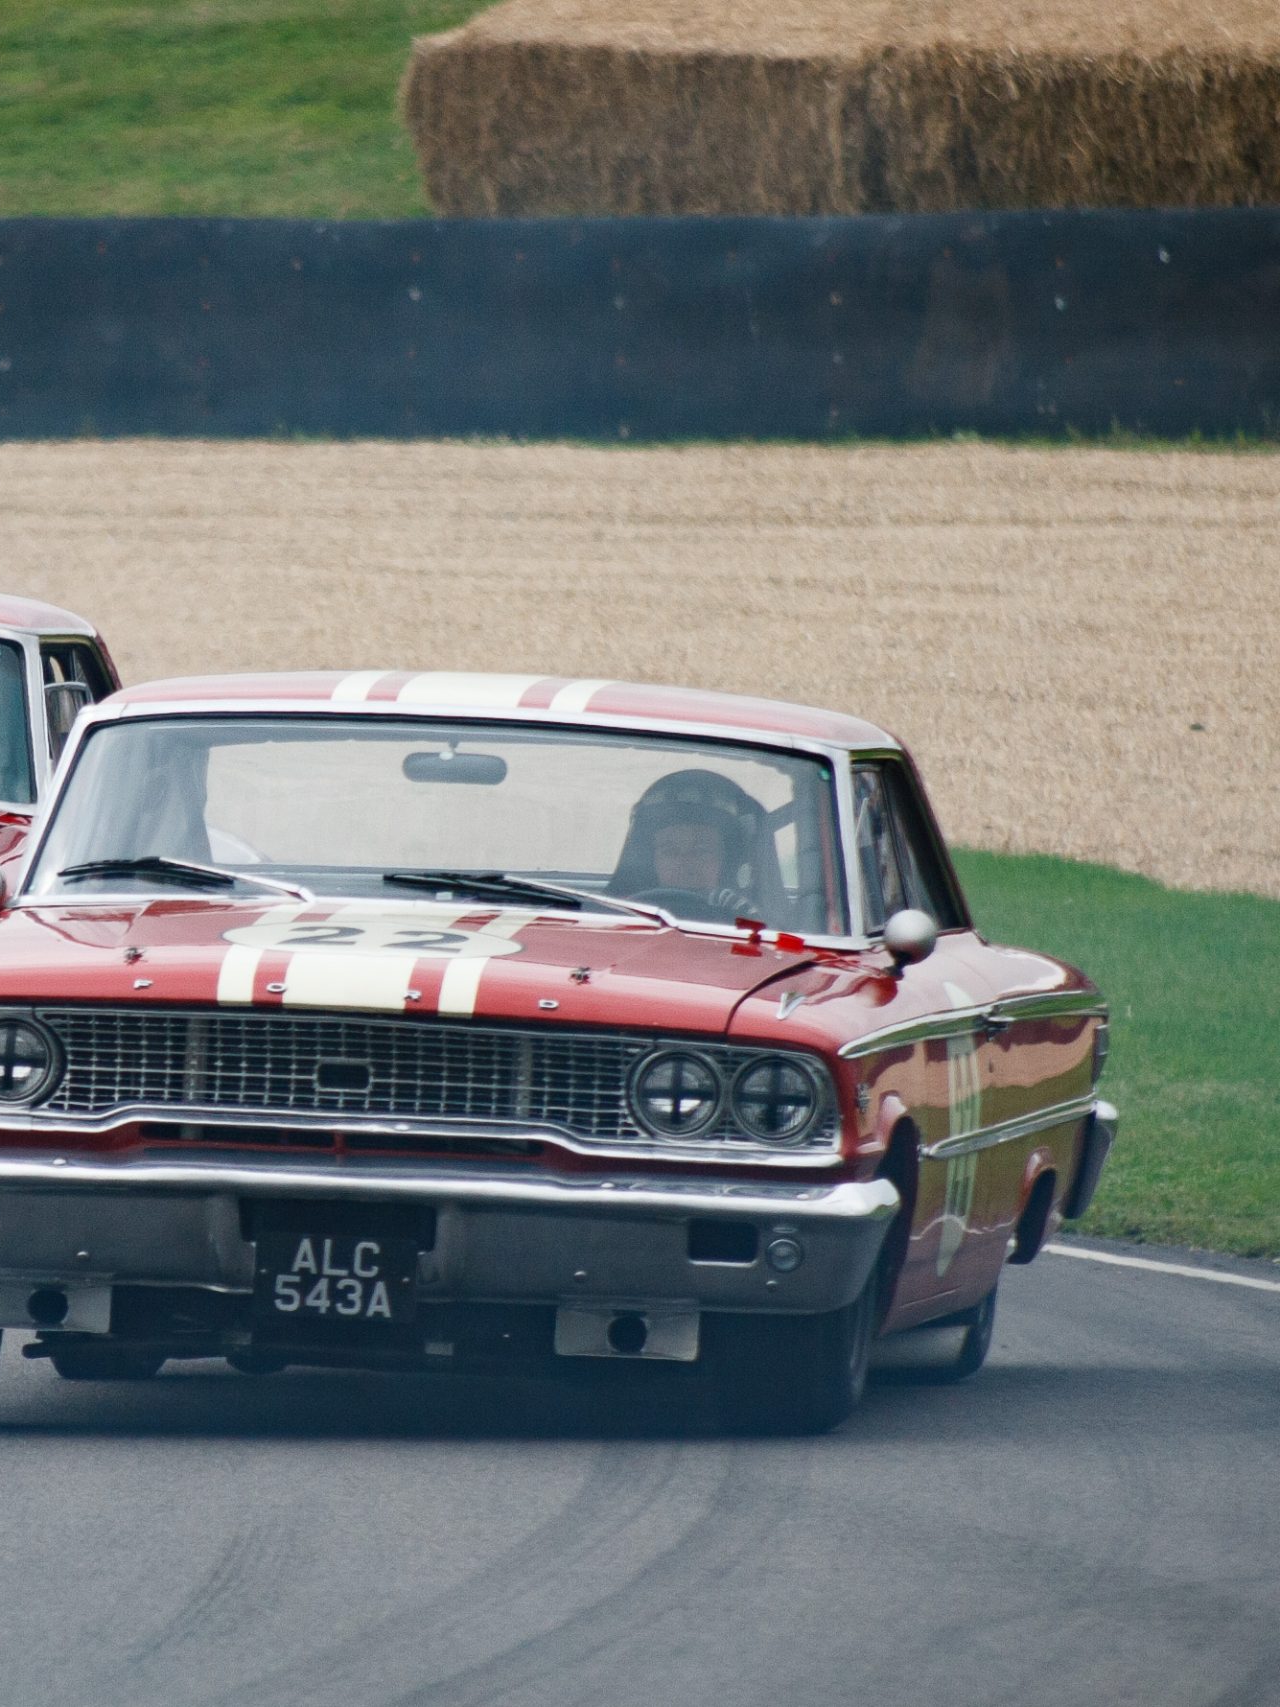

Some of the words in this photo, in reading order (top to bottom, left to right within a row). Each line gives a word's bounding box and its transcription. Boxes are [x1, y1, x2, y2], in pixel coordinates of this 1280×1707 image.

[278, 926, 470, 954] 22
[291, 1237, 380, 1279] ALC
[274, 1273, 392, 1318] 543A
